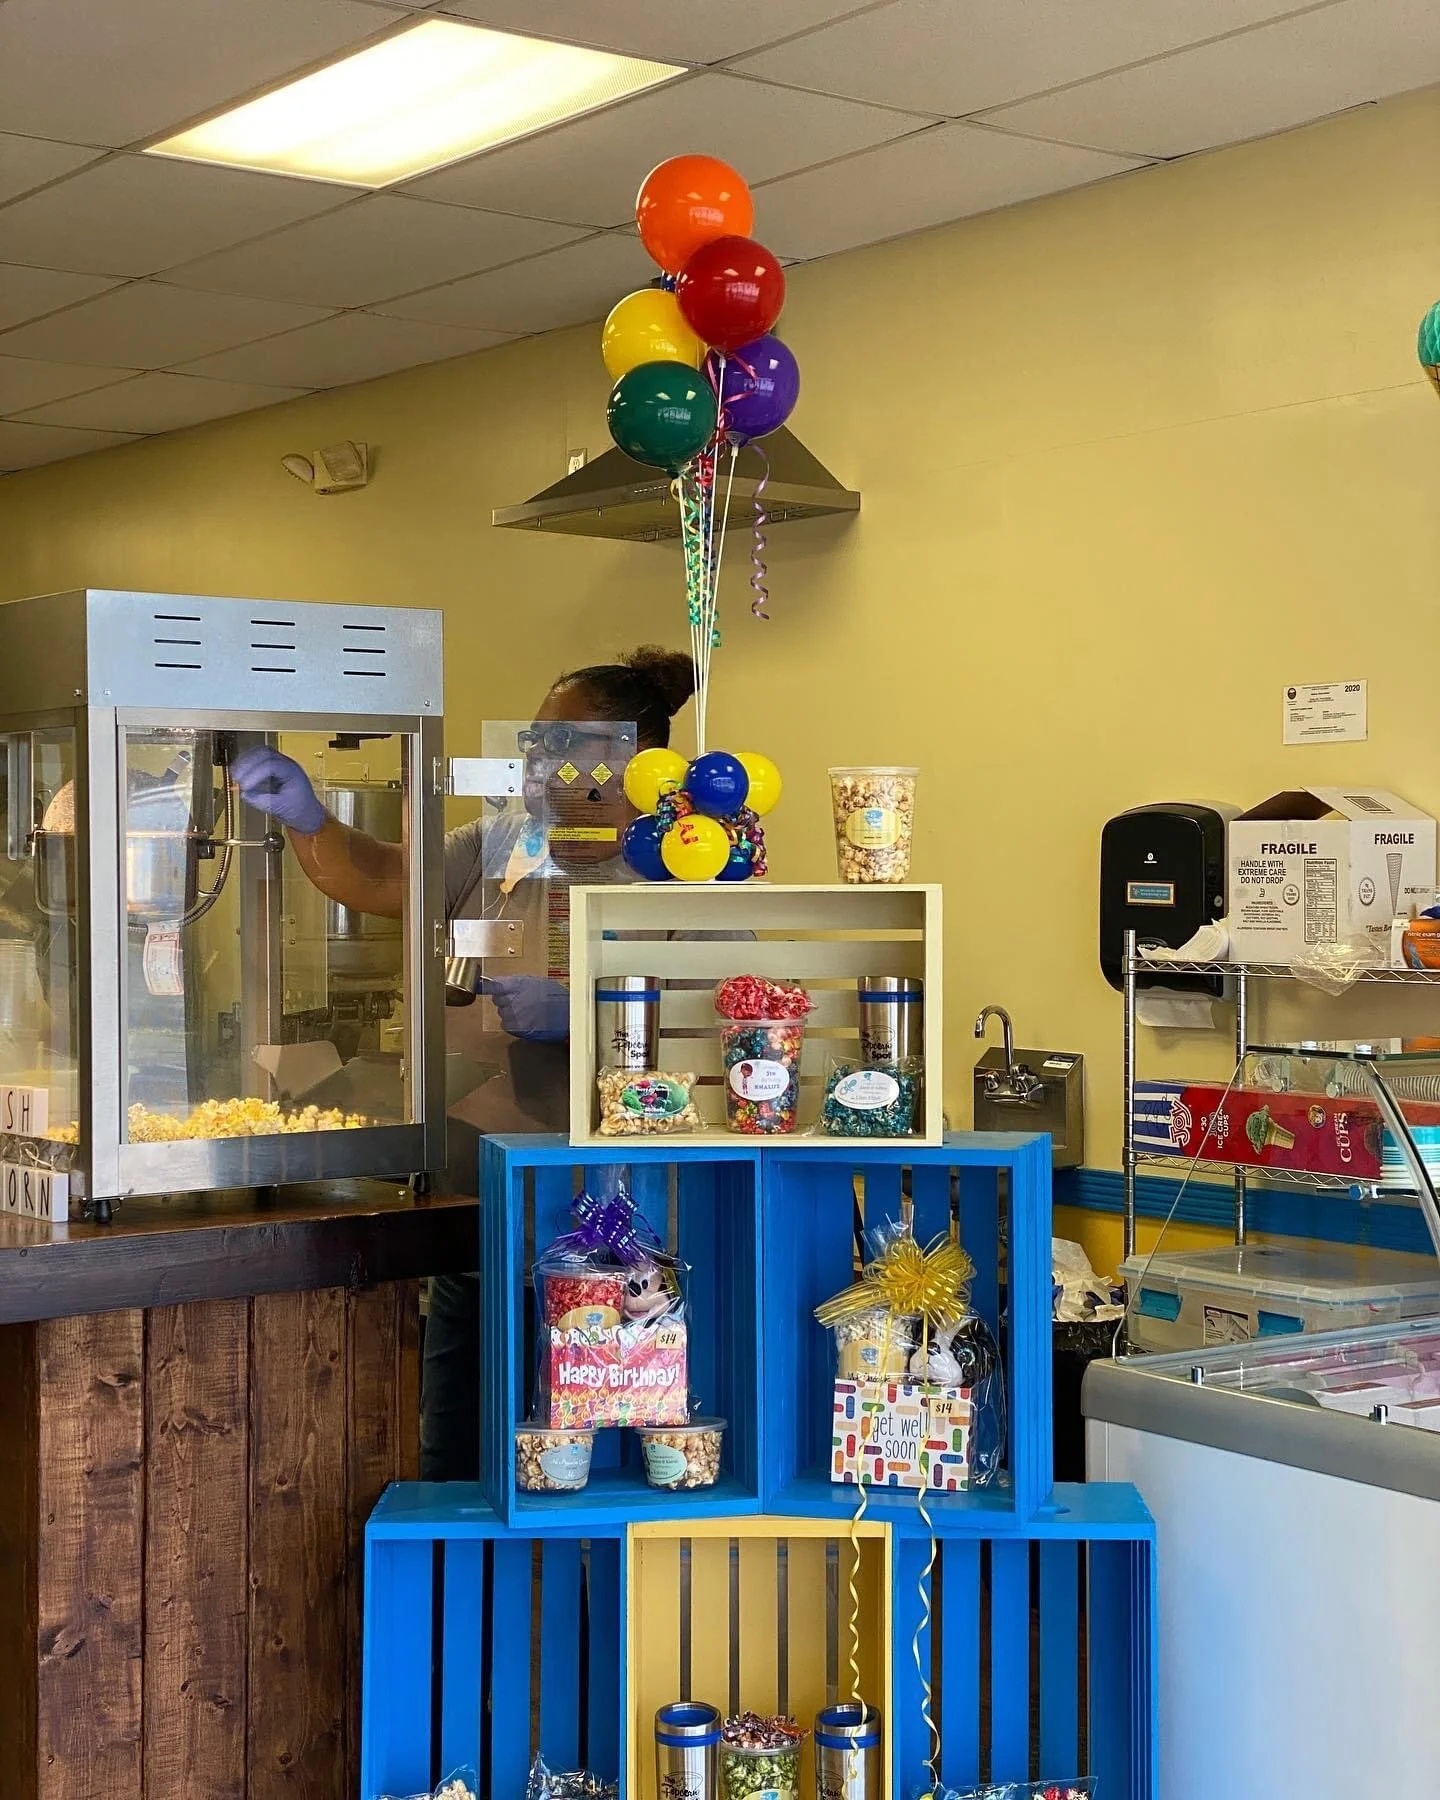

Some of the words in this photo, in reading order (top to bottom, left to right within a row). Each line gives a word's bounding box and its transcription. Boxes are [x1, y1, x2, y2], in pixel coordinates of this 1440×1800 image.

[1344, 684, 1361, 693] 2020
[1374, 833, 1415, 845] FRAGILE
[1261, 843, 1317, 855] FRAGILE
[1240, 860, 1267, 868] HANDLE
[1267, 860, 1284, 868] WITH
[1238, 868, 1268, 876] EXTREME
[1268, 868, 1287, 876] CARE
[1240, 876, 1250, 884] DO
[1251, 876, 1265, 884] NOT
[1265, 876, 1284, 884] DROP
[1339, 1112, 1352, 1163] CUPS
[660, 1333, 676, 1344] $14
[935, 1402, 952, 1414] $14
[872, 1412, 894, 1443] get
[901, 1411, 931, 1438] well
[885, 1440, 917, 1460] soon
